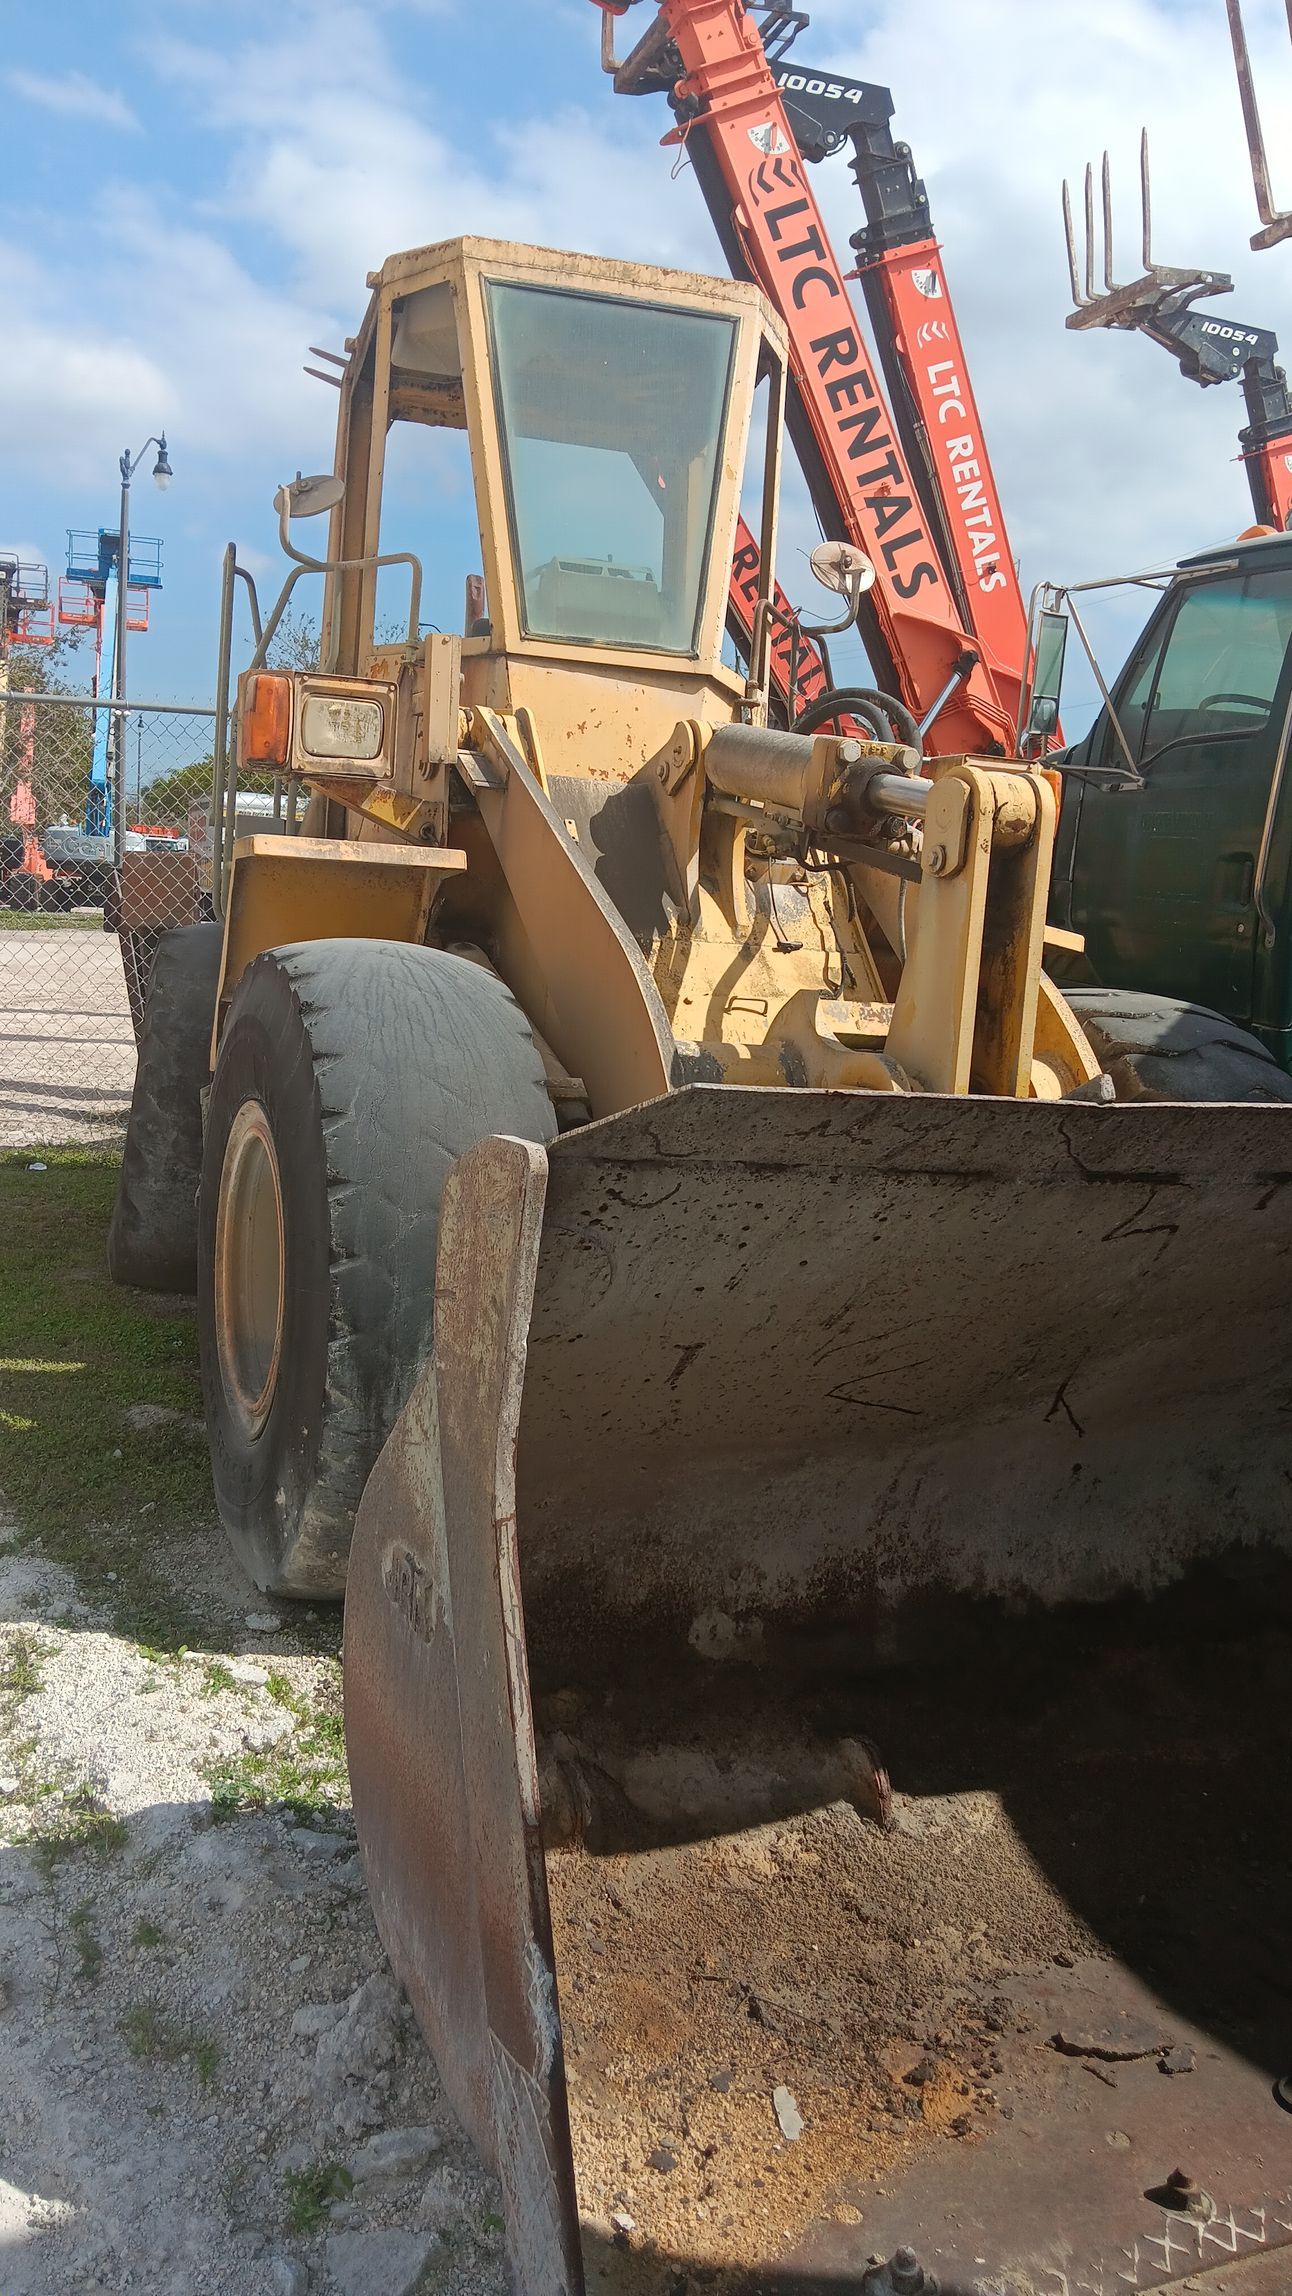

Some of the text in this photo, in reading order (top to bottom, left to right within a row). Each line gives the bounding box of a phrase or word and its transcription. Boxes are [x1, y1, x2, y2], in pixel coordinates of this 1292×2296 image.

[778, 72, 863, 104] 10054
[763, 197, 939, 599] LTC RENTALS
[1201, 321, 1259, 346] 10054
[927, 360, 1007, 593] LTC RENTALS
